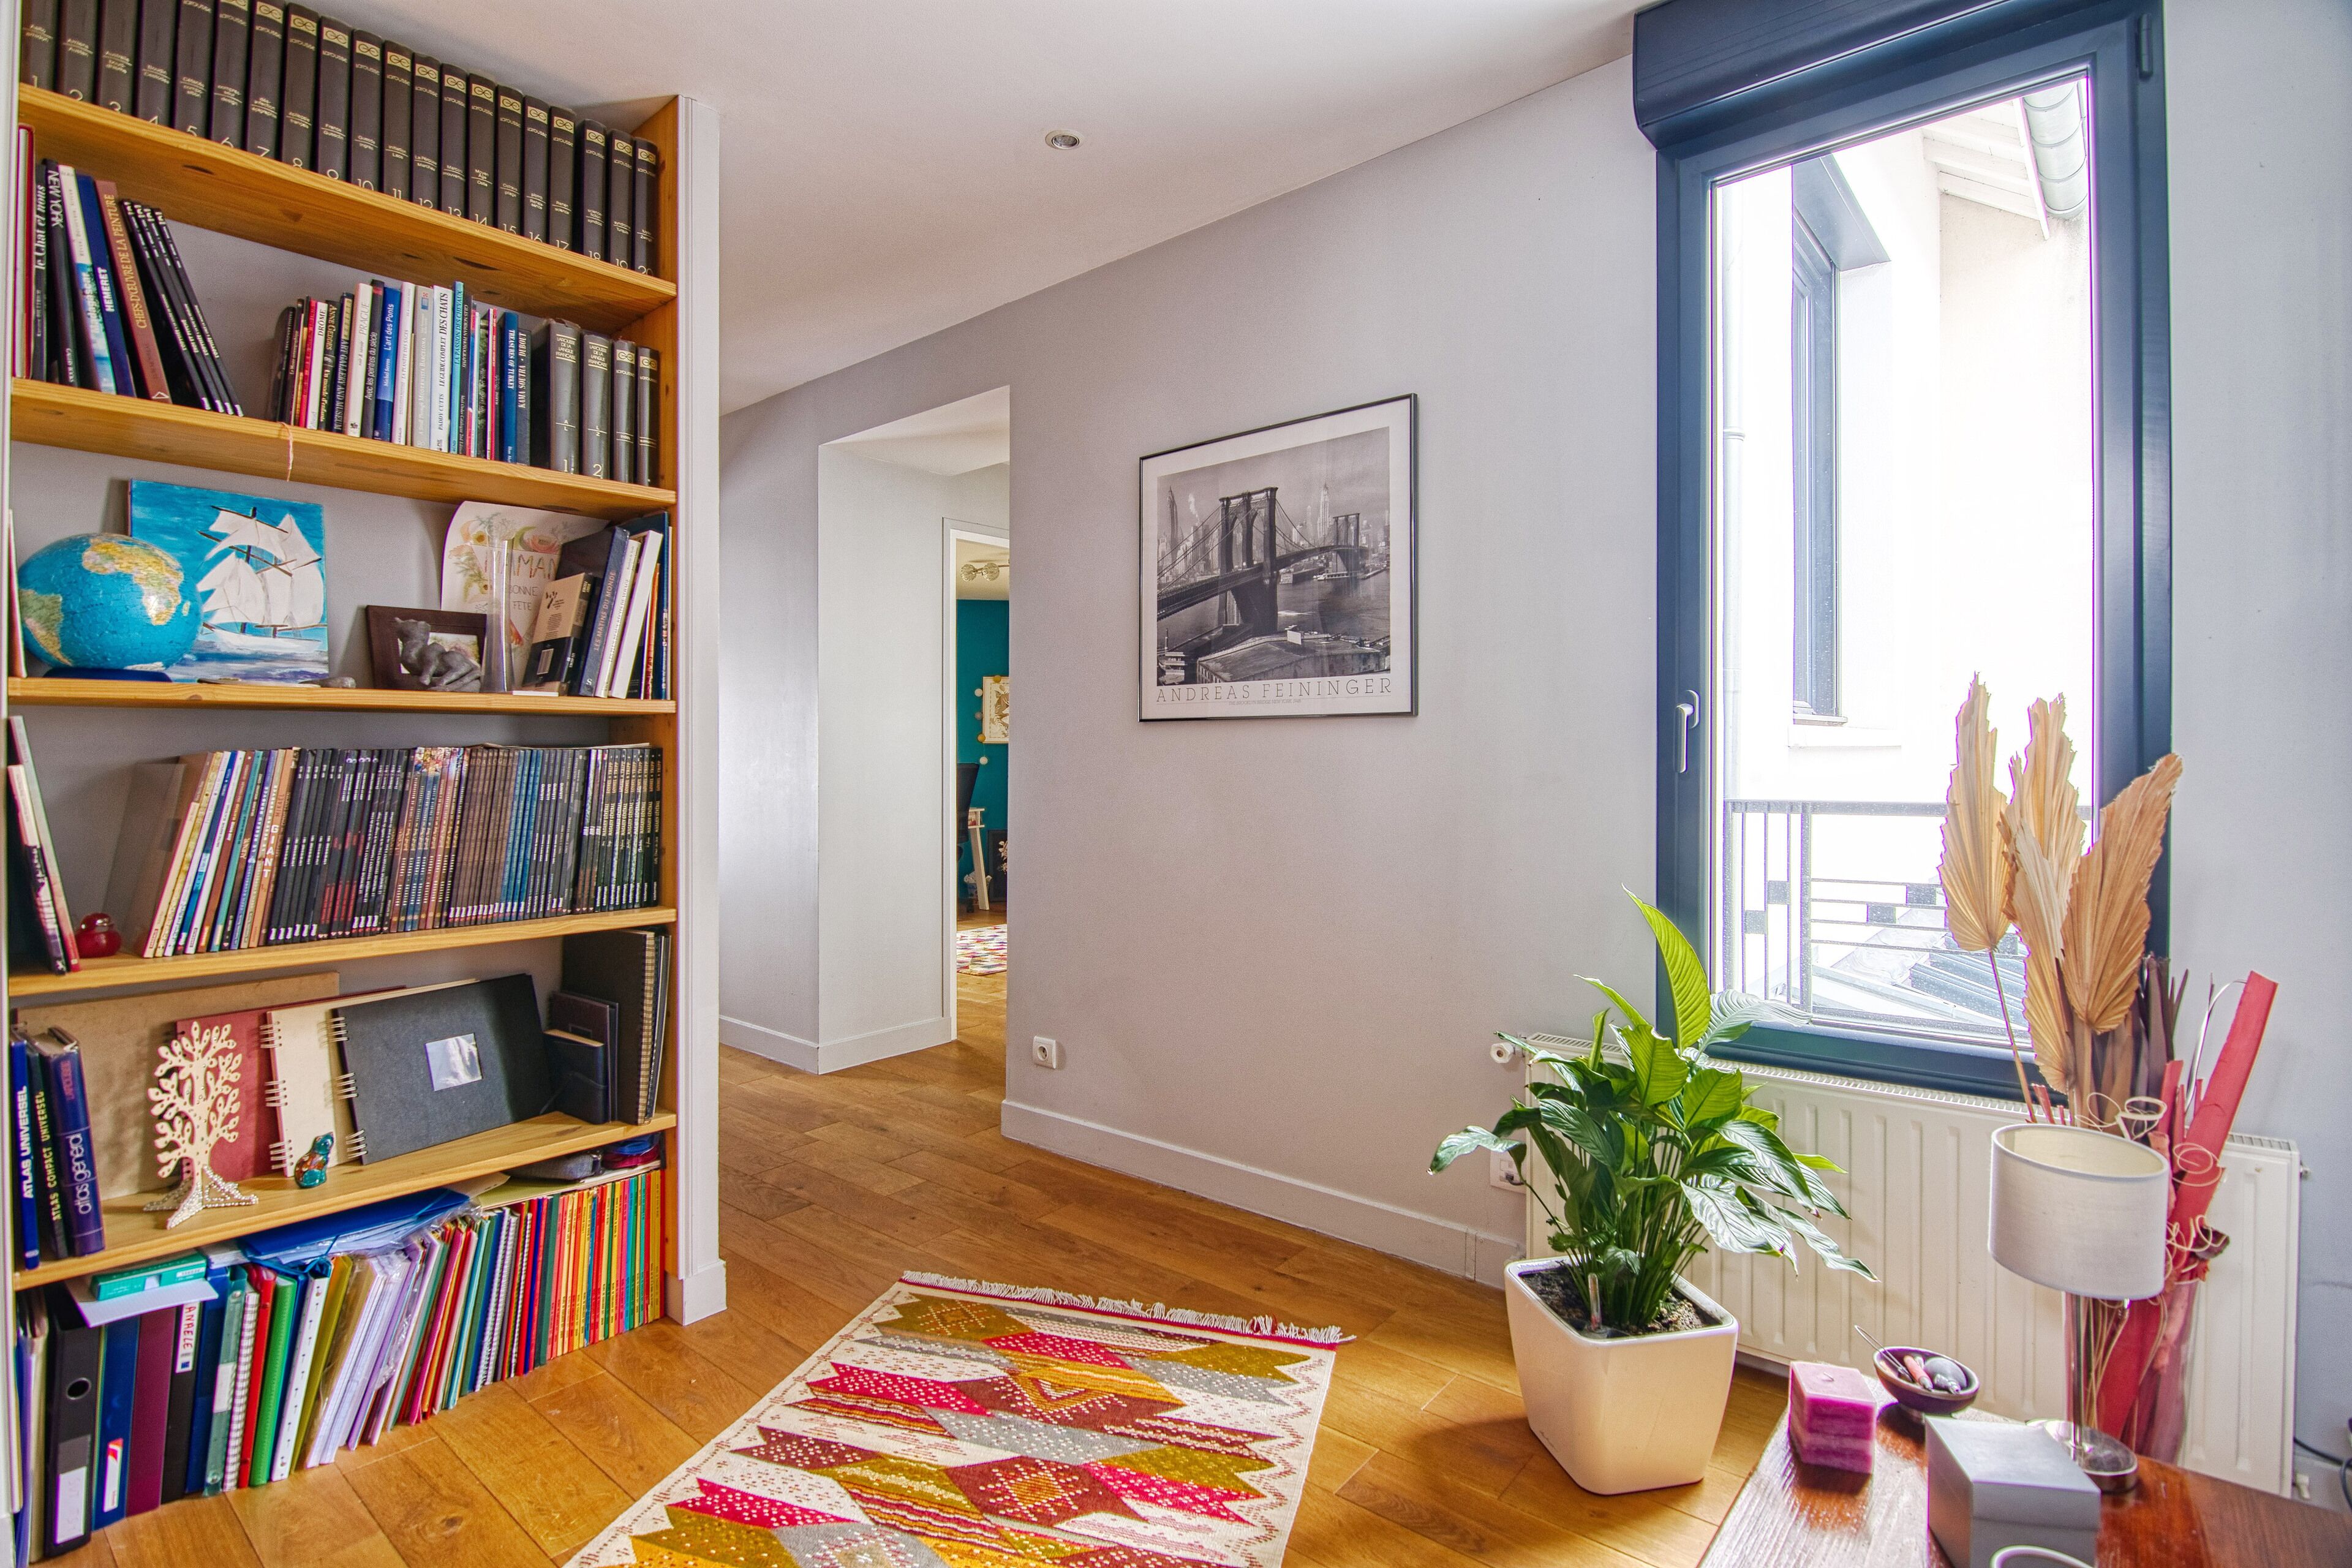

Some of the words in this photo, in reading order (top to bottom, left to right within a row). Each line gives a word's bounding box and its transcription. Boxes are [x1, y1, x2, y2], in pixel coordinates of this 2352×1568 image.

[46, 169, 61, 197] NEW
[35, 185, 46, 213] nous
[48, 199, 64, 228] YORK
[104, 193, 124, 238] PEINTURE
[115, 238, 127, 251] LA
[118, 251, 130, 263] DE
[97, 266, 114, 312] HEMERET
[326, 304, 338, 323] ANNE
[386, 303, 395, 322] Ponts
[439, 293, 449, 318] CHATS
[454, 290, 463, 318] CHEVAUX
[317, 309, 326, 336] DRÔME
[358, 302, 371, 335] PRAGUE
[439, 319, 448, 334] DES
[325, 324, 336, 350] GEDDES
[340, 339, 350, 353] ART
[383, 336, 393, 350] L'art
[453, 331, 462, 355] PASSION
[589, 345, 607, 353] LAROUSSE
[336, 354, 348, 385] GALLERY
[366, 356, 377, 377] peintres
[336, 385, 345, 400] AND
[364, 386, 374, 400] Avec
[318, 397, 327, 421] d'enfants
[333, 401, 345, 429] MUSEUM
[564, 459, 568, 472] 1
[593, 464, 602, 476] 2
[604, 571, 617, 597] MONDE
[601, 598, 610, 609] DU
[595, 611, 608, 637] MATINS
[592, 639, 601, 651] LES
[1156, 685, 1250, 702] ANDREAS
[1262, 678, 1392, 698] FEININGER
[262, 824, 279, 878] GIANT
[17, 1085, 32, 1156] UNIVERSEL
[36, 1091, 51, 1142] UNIVERSEL
[20, 1159, 34, 1198] ATLAS
[42, 1146, 58, 1188] COMPACT
[48, 1192, 62, 1220] ATLAS
[72, 1183, 92, 1215] atlas
